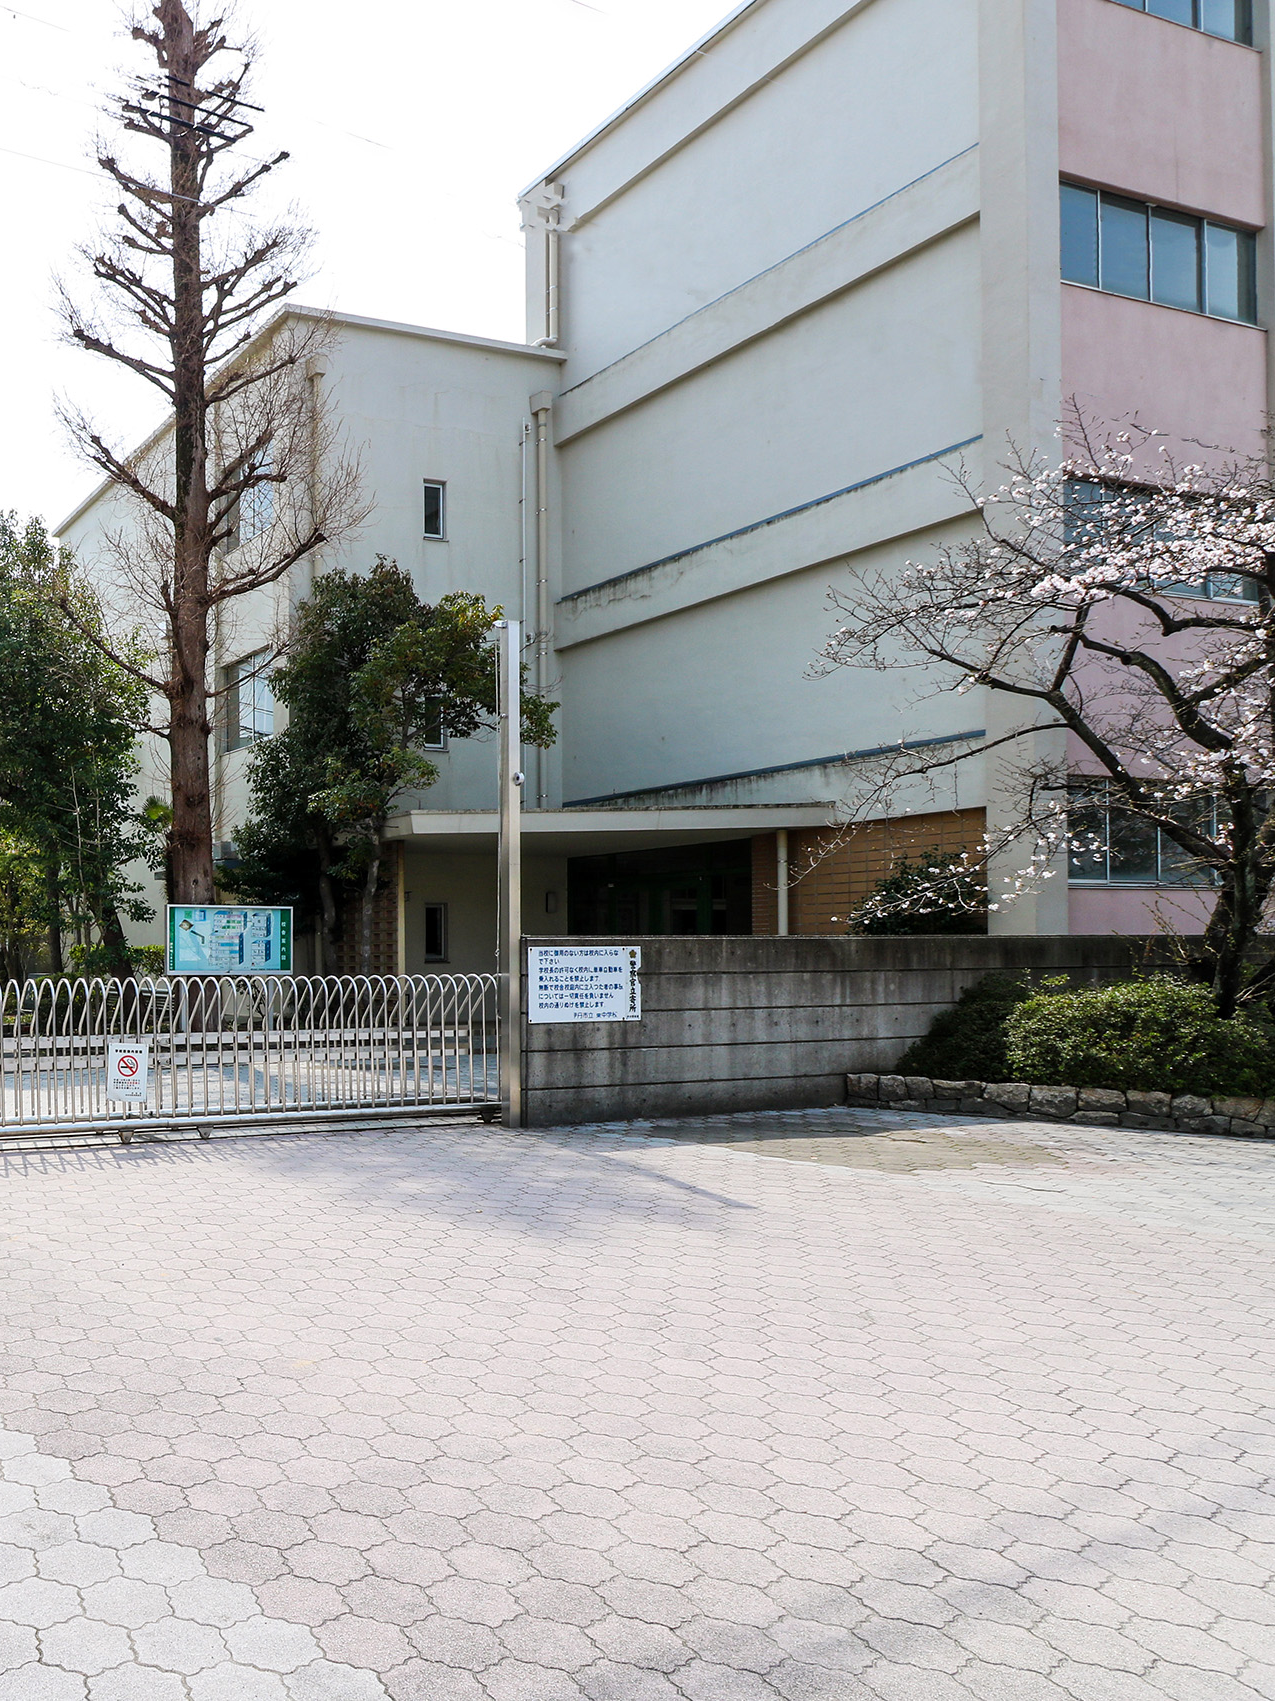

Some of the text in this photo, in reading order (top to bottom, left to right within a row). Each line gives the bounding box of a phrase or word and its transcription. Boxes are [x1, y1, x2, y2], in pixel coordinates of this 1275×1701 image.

[629, 959, 637, 1013] 警察官立寄所
